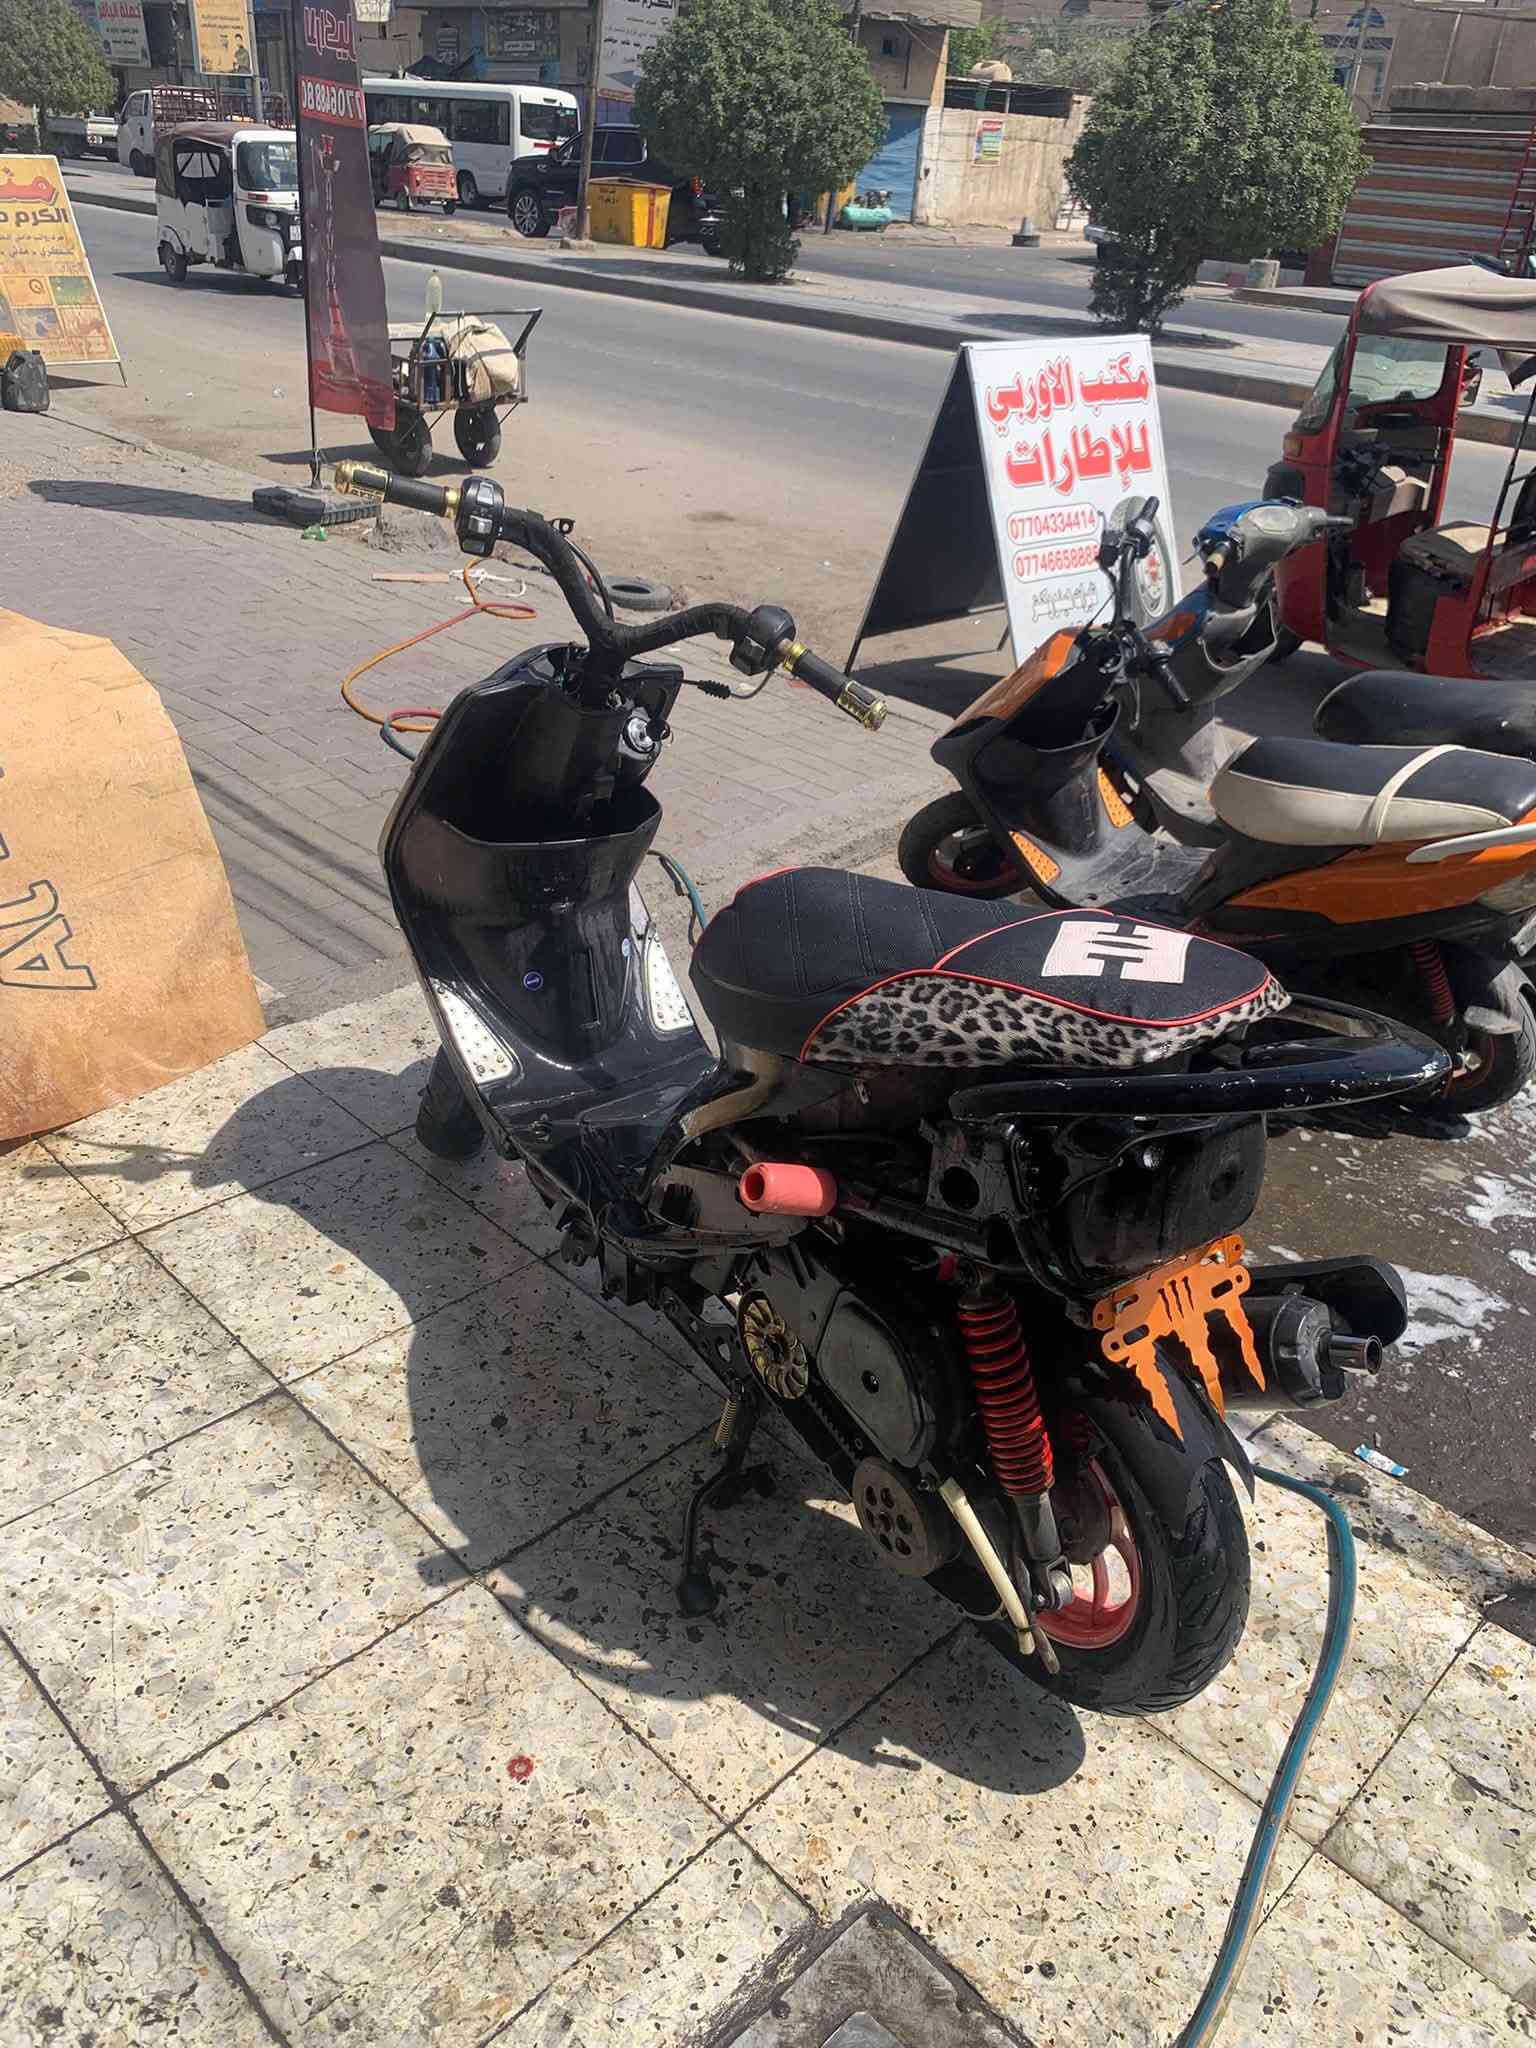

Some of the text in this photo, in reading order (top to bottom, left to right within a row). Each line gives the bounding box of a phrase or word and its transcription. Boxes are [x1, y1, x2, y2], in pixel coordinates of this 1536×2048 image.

[1079, 352, 1151, 417] مكتب
[1003, 420, 1153, 496] للإطارات
[1010, 509, 1096, 540] 07704334414
